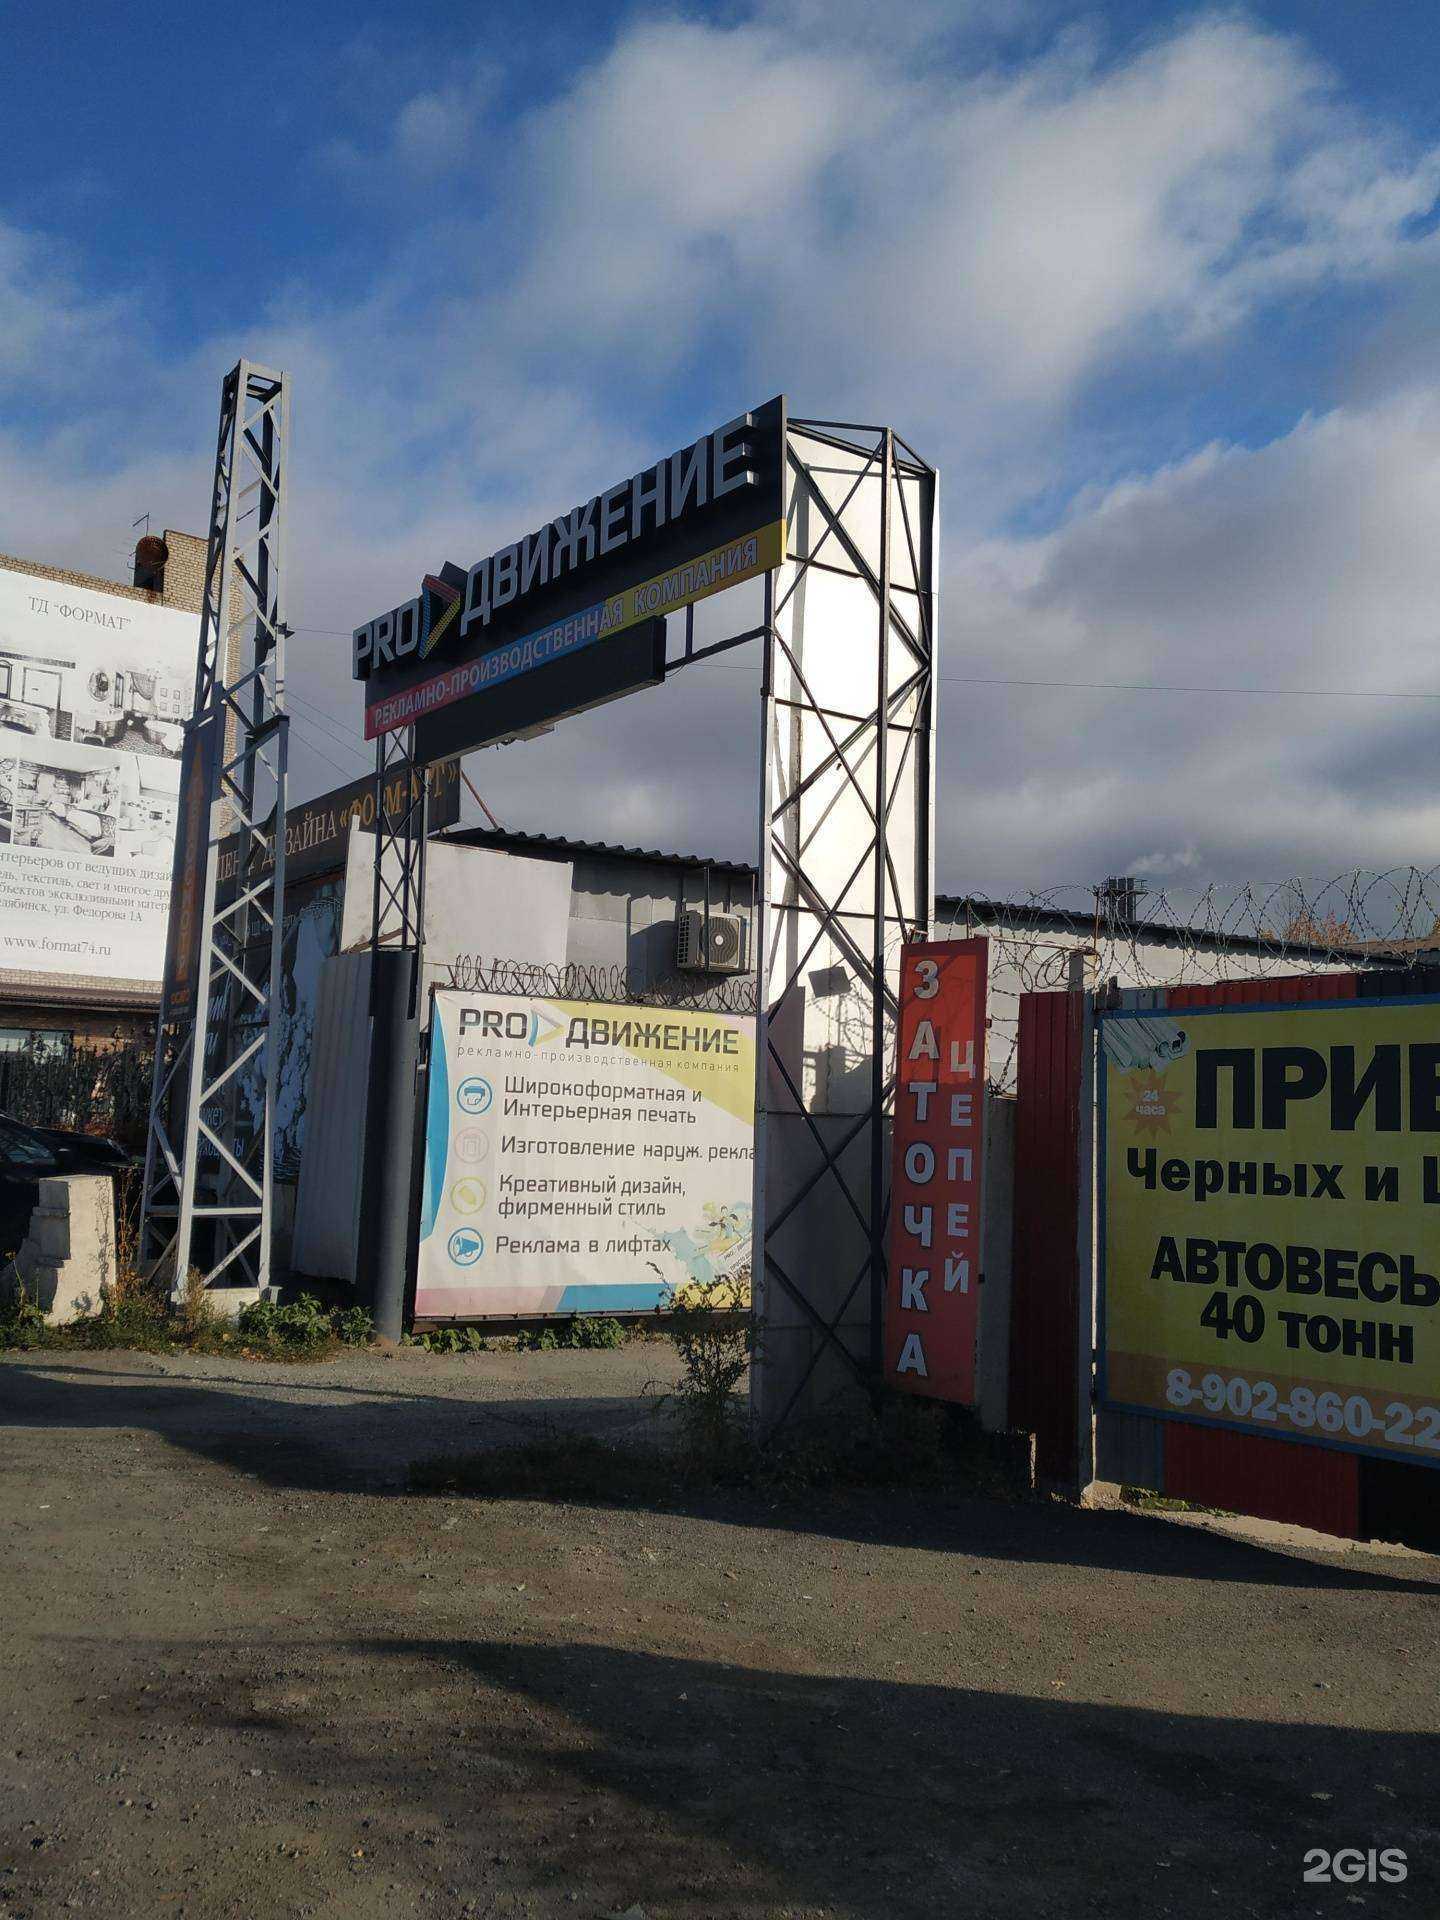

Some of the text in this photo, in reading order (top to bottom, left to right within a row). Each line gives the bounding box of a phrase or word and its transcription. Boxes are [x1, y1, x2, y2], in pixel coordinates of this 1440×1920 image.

[352, 412, 759, 679] PRO ДВИЖЕНИЕ
[28, 597, 49, 614] ТД
[374, 536, 758, 728] РЕКЛАМНО-ПРОИЗВОДСТВЕННАЯ КОМПАНИЯ
[67, 861, 82, 870] от
[85, 863, 137, 878] ведущих
[76, 880, 100, 890] свет
[103, 883, 110, 891] и
[113, 885, 152, 897] многое
[73, 904, 126, 920] Федорова
[3, 936, 112, 956] www.format74.ru
[459, 1008, 739, 1054] PRO ДВИЖЕНИЕ
[677, 1060, 739, 1073] компания
[505, 1075, 702, 1103] Широкоформатная и
[503, 1098, 697, 1124] Интерьерная печать
[1135, 1105, 1166, 1116] часа
[501, 1135, 635, 1157] Изготовление
[642, 1143, 703, 1162] наруж.
[896, 959, 940, 1377] ЗАТОЧКА
[943, 1040, 977, 1295] ЦЕПЕЙ
[1127, 1147, 1346, 1202] Черных
[1365, 1165, 1399, 1202] и
[500, 1174, 687, 1197] Креативный дизайн,
[498, 1197, 666, 1219] фирменный стиль
[496, 1234, 672, 1256] Реклама в лифтах
[1200, 1291, 1415, 1364] 40 тонн
[1165, 1368, 1440, 1451] 8-902-860-22
